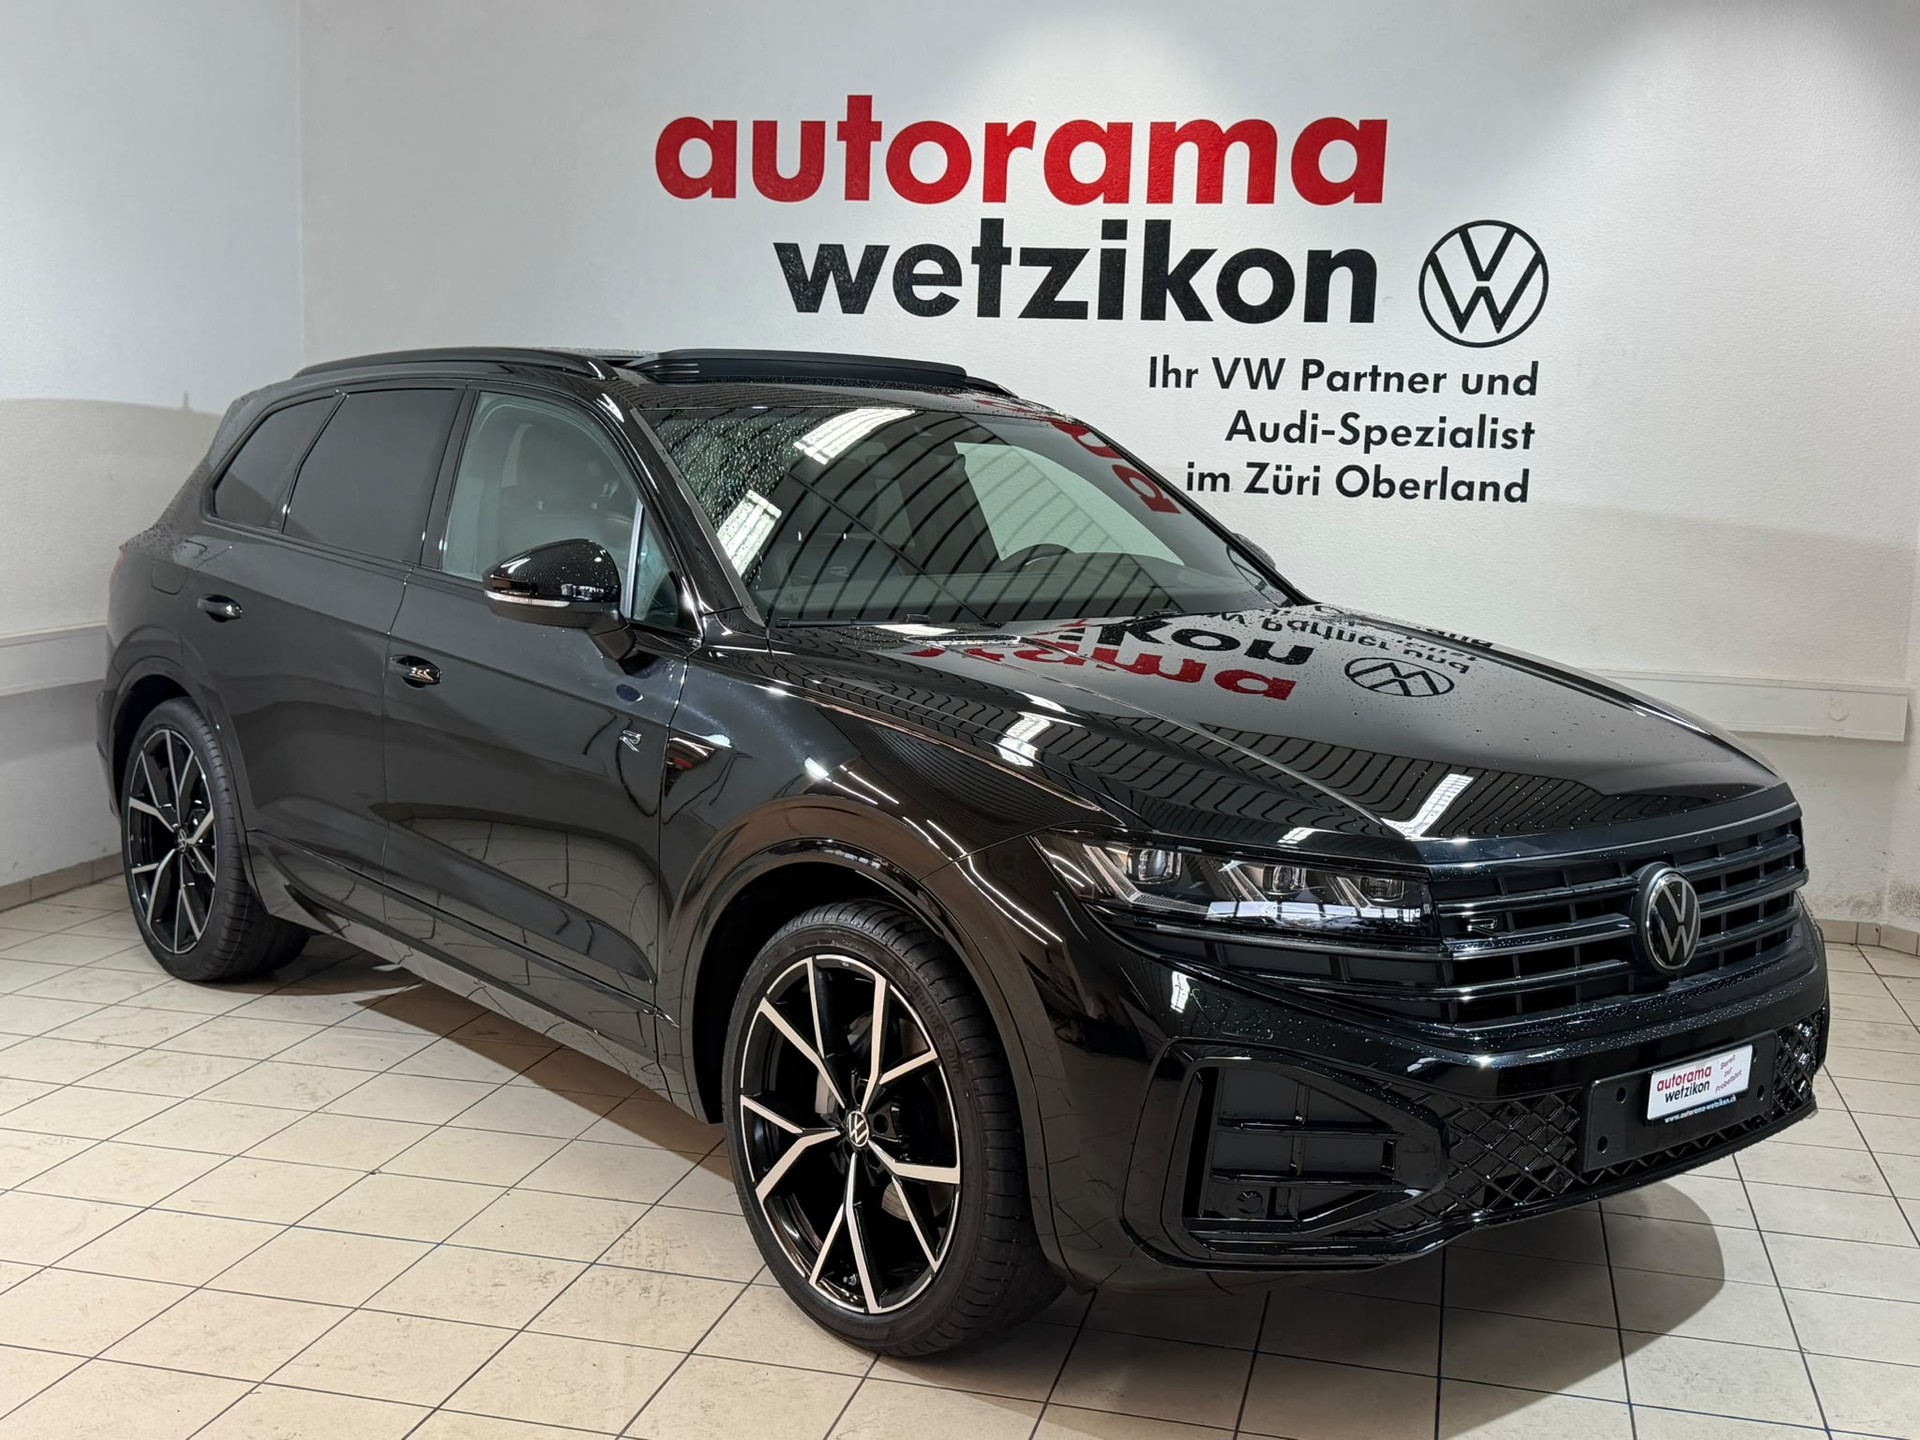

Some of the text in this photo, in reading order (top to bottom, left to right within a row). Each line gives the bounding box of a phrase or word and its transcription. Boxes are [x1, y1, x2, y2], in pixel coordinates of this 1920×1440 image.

[655, 95, 1388, 206] autorama
[773, 218, 1378, 324] wetzikon
[1149, 355, 1539, 396] Ihr VW Partner und
[1225, 409, 1536, 454] Audi-Spezialist
[1186, 461, 1530, 503] im Züri Oberland
[1656, 1064, 1713, 1092] autorama
[1664, 1080, 1710, 1103] wetzikon
